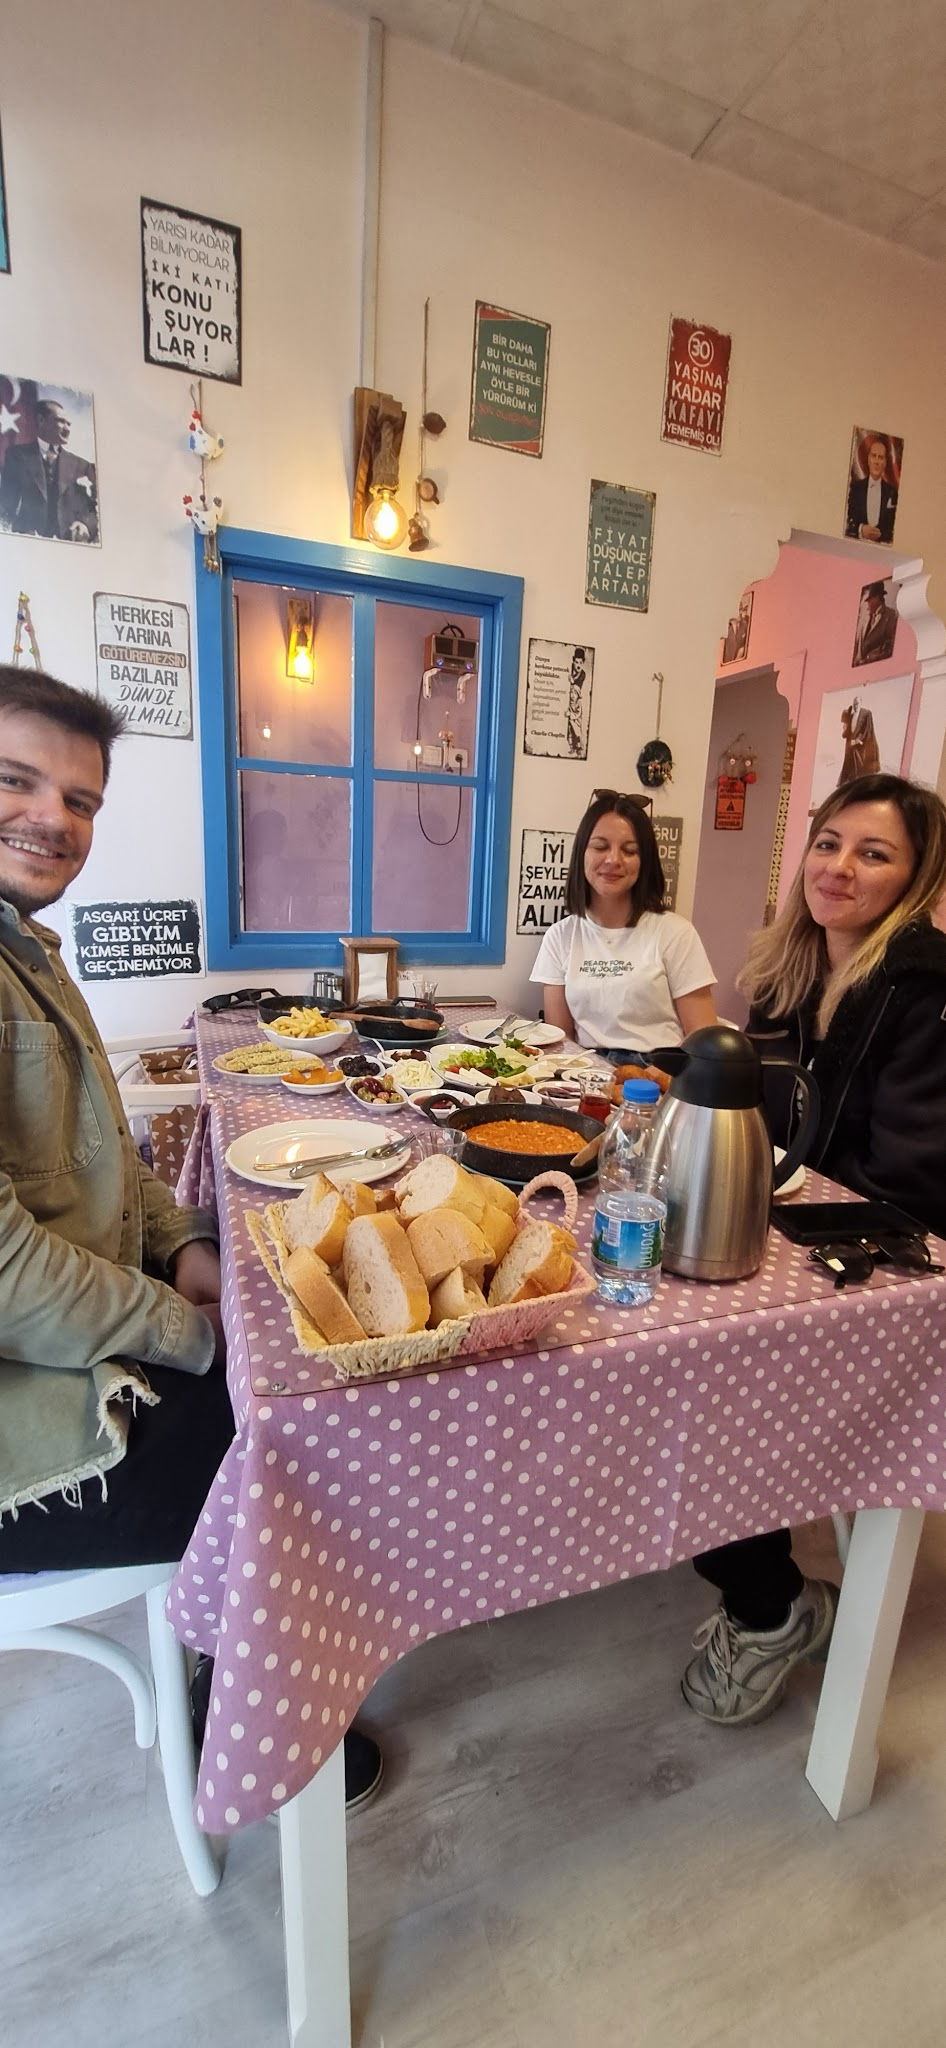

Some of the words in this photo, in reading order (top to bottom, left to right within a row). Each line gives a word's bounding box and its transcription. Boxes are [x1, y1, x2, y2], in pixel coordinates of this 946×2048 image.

[150, 216, 187, 240] YARISI
[191, 228, 230, 254] KADAR
[150, 235, 230, 272] BİLMİYORLAR
[152, 260, 181, 279] İKİ
[152, 279, 212, 312] KONU
[165, 309, 233, 344] ŞUYOR
[157, 332, 196, 359] LAR
[492, 333, 507, 347] BİR
[509, 339, 533, 355] DAHA
[691, 338, 711, 360] 30
[486, 347, 500, 359] BU
[502, 352, 537, 371] YOLLARI
[480, 360, 501, 375] AYNI
[502, 366, 542, 387] HEVESLE
[674, 360, 723, 389] YAŞINA
[490, 375, 514, 393] ÖYLE
[515, 383, 530, 398] BİR
[671, 380, 722, 410] KADAR
[527, 401, 537, 414] Kİ
[668, 399, 721, 432] KAFAYI
[666, 421, 705, 443] YEMEMİŞ
[594, 526, 647, 549] FİYAT
[593, 542, 647, 566] DÜŞÜNCE
[592, 560, 646, 581] TALEP
[110, 604, 174, 629] HERKESİ
[114, 625, 172, 647] YARINA
[102, 645, 186, 668] GÖTÜREMEZSİN
[110, 664, 179, 687] BAZILARI
[116, 684, 176, 706] DÜNDE
[543, 837, 565, 863] İYİ
[525, 865, 569, 882] ŞEYLE
[522, 884, 565, 900] ZAMA
[82, 908, 140, 924] ASGARİ
[143, 908, 188, 922] ÜCRET
[92, 922, 181, 943] GİBİYİM
[80, 943, 130, 958] KİMSE
[133, 941, 195, 957] BENİMLE
[84, 956, 193, 976] GEÇİNEMİYOR
[639, 1222, 656, 1268] ULUDAĞ
